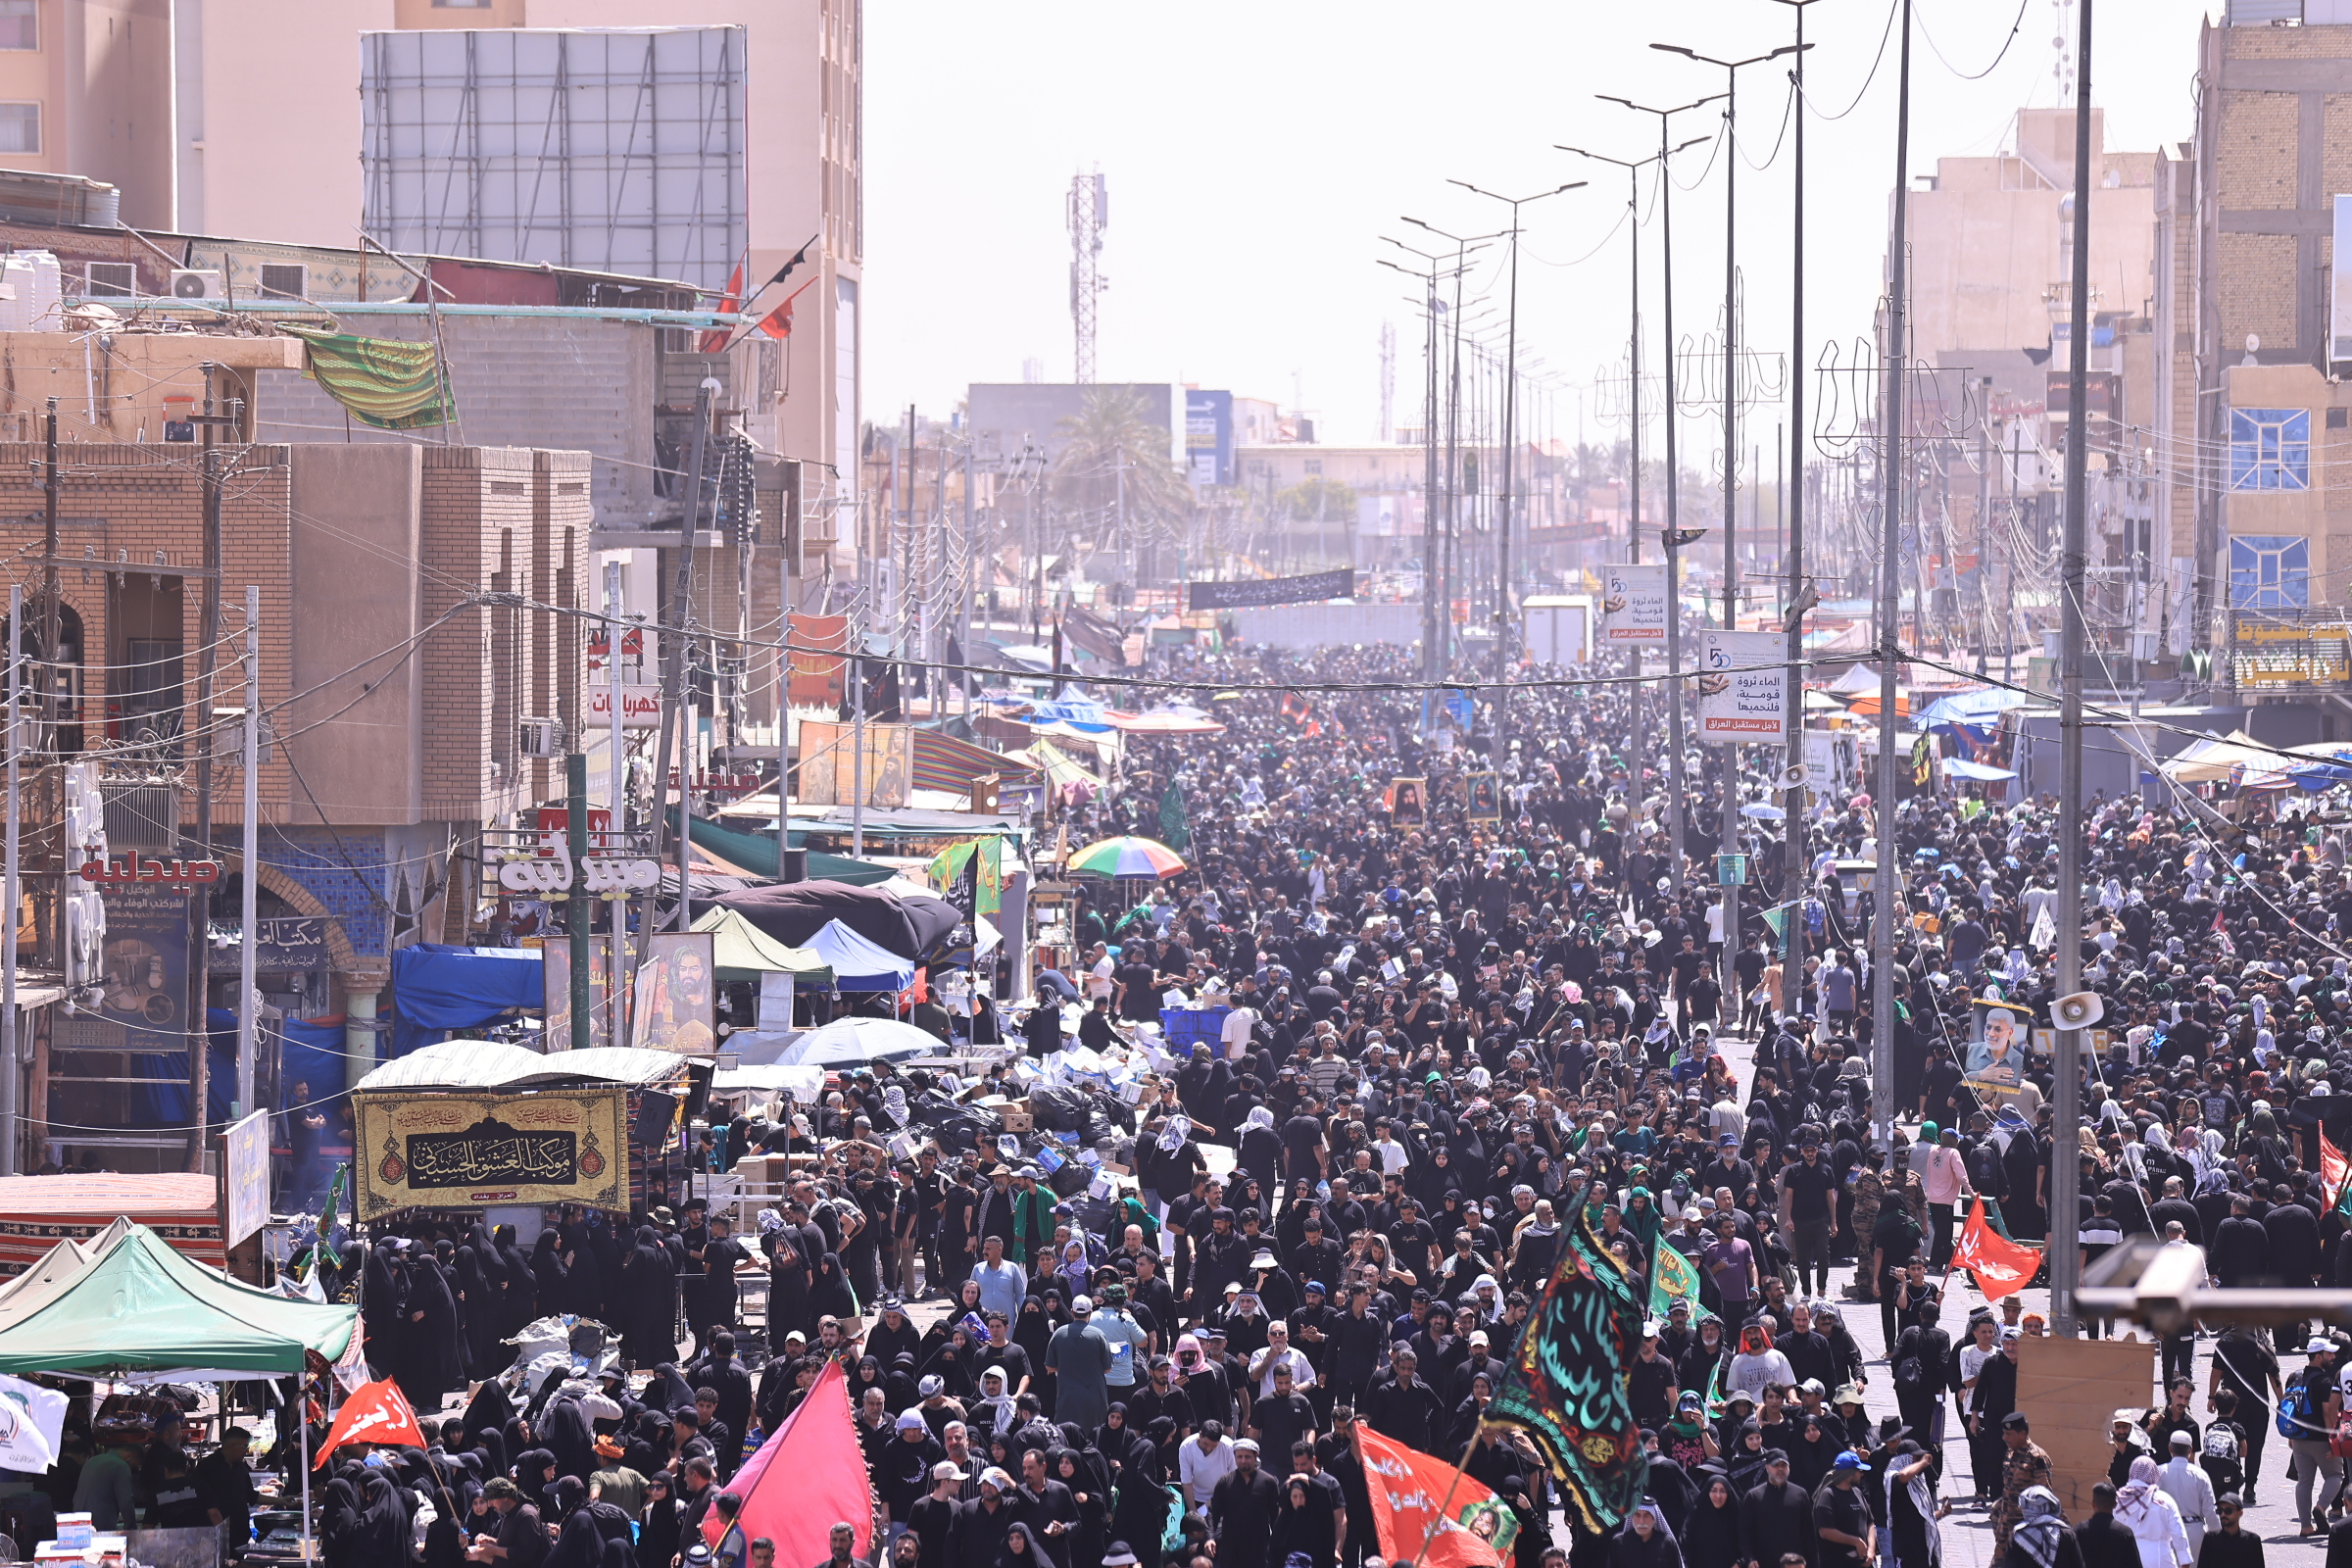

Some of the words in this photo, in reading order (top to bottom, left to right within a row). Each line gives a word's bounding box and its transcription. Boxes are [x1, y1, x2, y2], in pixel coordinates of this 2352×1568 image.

[1632, 597, 1646, 606] ثروة
[1611, 630, 1628, 639] العراق
[1738, 675, 1757, 687] ثروة
[1759, 677, 1780, 686] الماء
[592, 693, 661, 717] كهربايات
[1738, 702, 1780, 712] فلنحميها
[1708, 719, 1731, 729] العراق
[1733, 720, 1760, 730] مستقبل
[1761, 720, 1778, 730] لأجل
[80, 845, 219, 895] صيدلية
[499, 831, 661, 902] صيدلية
[126, 884, 155, 896] الوكيل
[123, 898, 148, 909] الوفاء
[149, 899, 184, 909] لشركتي
[277, 920, 321, 953] مكتب
[2093, 1032, 2106, 1051] 6
[413, 1141, 477, 1183] الحسيني
[467, 1138, 533, 1182] العشق
[522, 1138, 571, 1179] موكب
[496, 1192, 514, 1200] العراق
